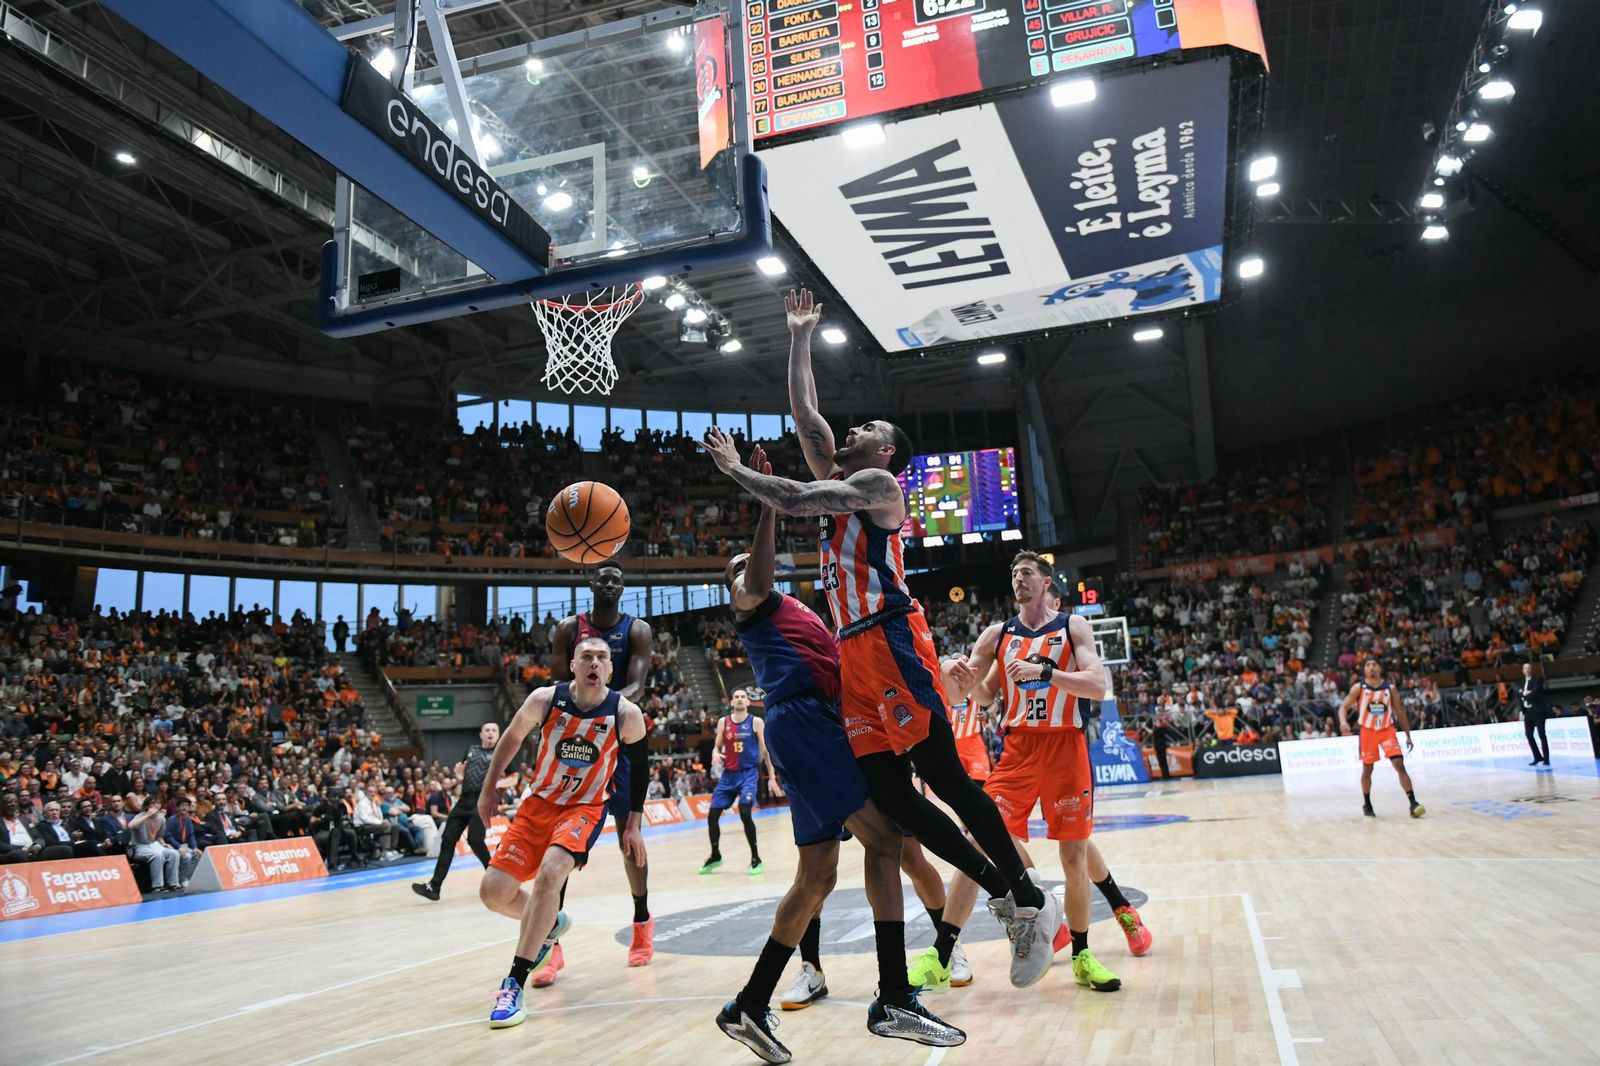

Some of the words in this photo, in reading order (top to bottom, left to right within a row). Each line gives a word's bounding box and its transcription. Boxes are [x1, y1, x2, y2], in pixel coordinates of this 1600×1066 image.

[751, 6, 761, 15] 12
[751, 24, 762, 34] 22
[866, 16, 877, 26] 13
[1029, 19, 1041, 30] 45
[779, 27, 830, 47] BARRUETA
[869, 36, 877, 46] 9
[1065, 24, 1116, 44] GRUJICIC
[752, 44, 763, 54] 23
[790, 49, 821, 64] SILINS
[753, 62, 764, 73] 25
[777, 65, 837, 87] HERNANDEZ
[754, 81, 766, 92] 30
[871, 74, 883, 86] 12
[777, 84, 840, 107] BURJANADZE
[755, 101, 767, 112] 77
[1179, 120, 1194, 149] 1962
[387, 99, 510, 226] endesa
[1180, 151, 1195, 178] dende
[1069, 138, 1118, 211] leite,
[1127, 127, 1179, 223] Leyma
[838, 138, 1011, 290] LEYMA
[822, 562, 839, 591] 23
[1082, 590, 1097, 604] 19
[1027, 698, 1047, 720] 22
[561, 743, 593, 754] Estrella
[561, 750, 590, 761] Galicia
[1203, 746, 1277, 764] endesa
[1096, 764, 1137, 783] LEYMA
[562, 775, 582, 793] 77
[255, 848, 311, 864] Fagamos
[261, 860, 300, 877] lenda
[41, 868, 120, 888] Fagamos
[47, 885, 101, 904] lenda
